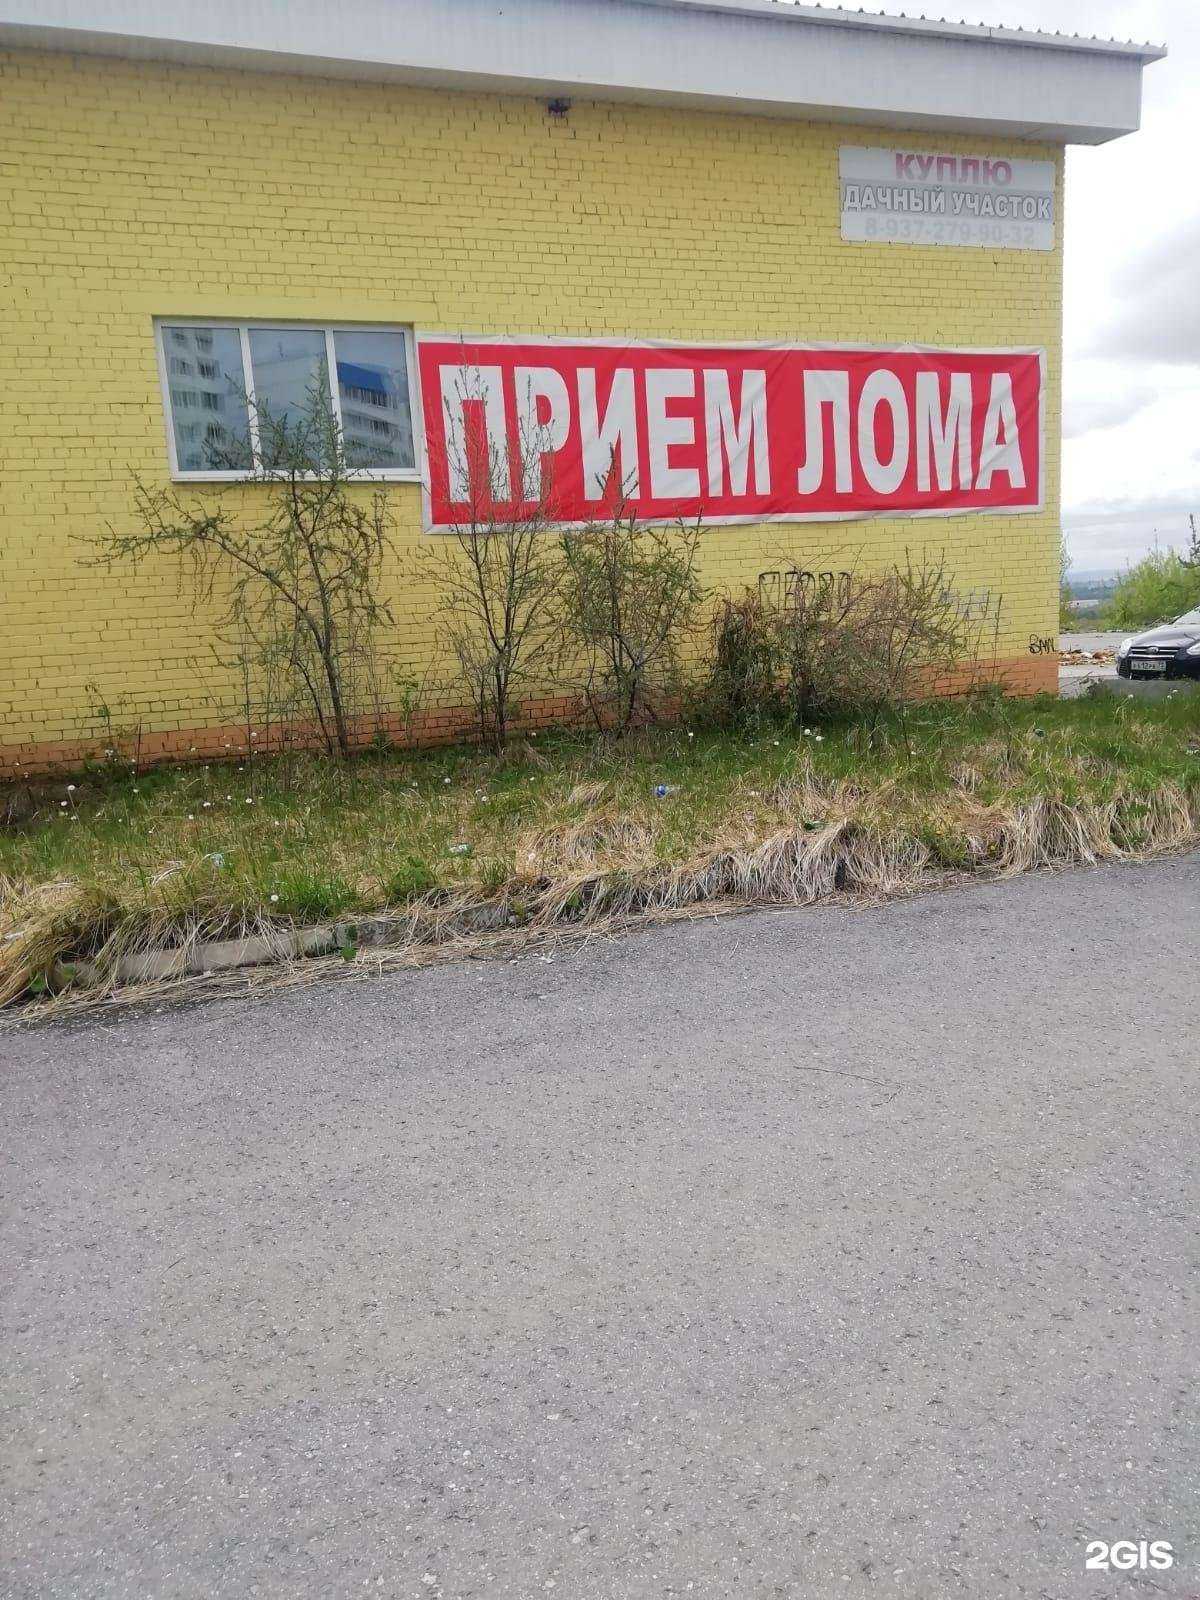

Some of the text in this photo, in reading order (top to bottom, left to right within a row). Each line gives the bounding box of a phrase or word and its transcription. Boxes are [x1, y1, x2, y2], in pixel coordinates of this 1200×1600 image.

[895, 153, 1012, 186] КУПЛЮ
[843, 184, 1051, 220] ДАЧНЫЙ УЧАСТОК
[438, 364, 1026, 503] ПРИЕМ ЛОМА
